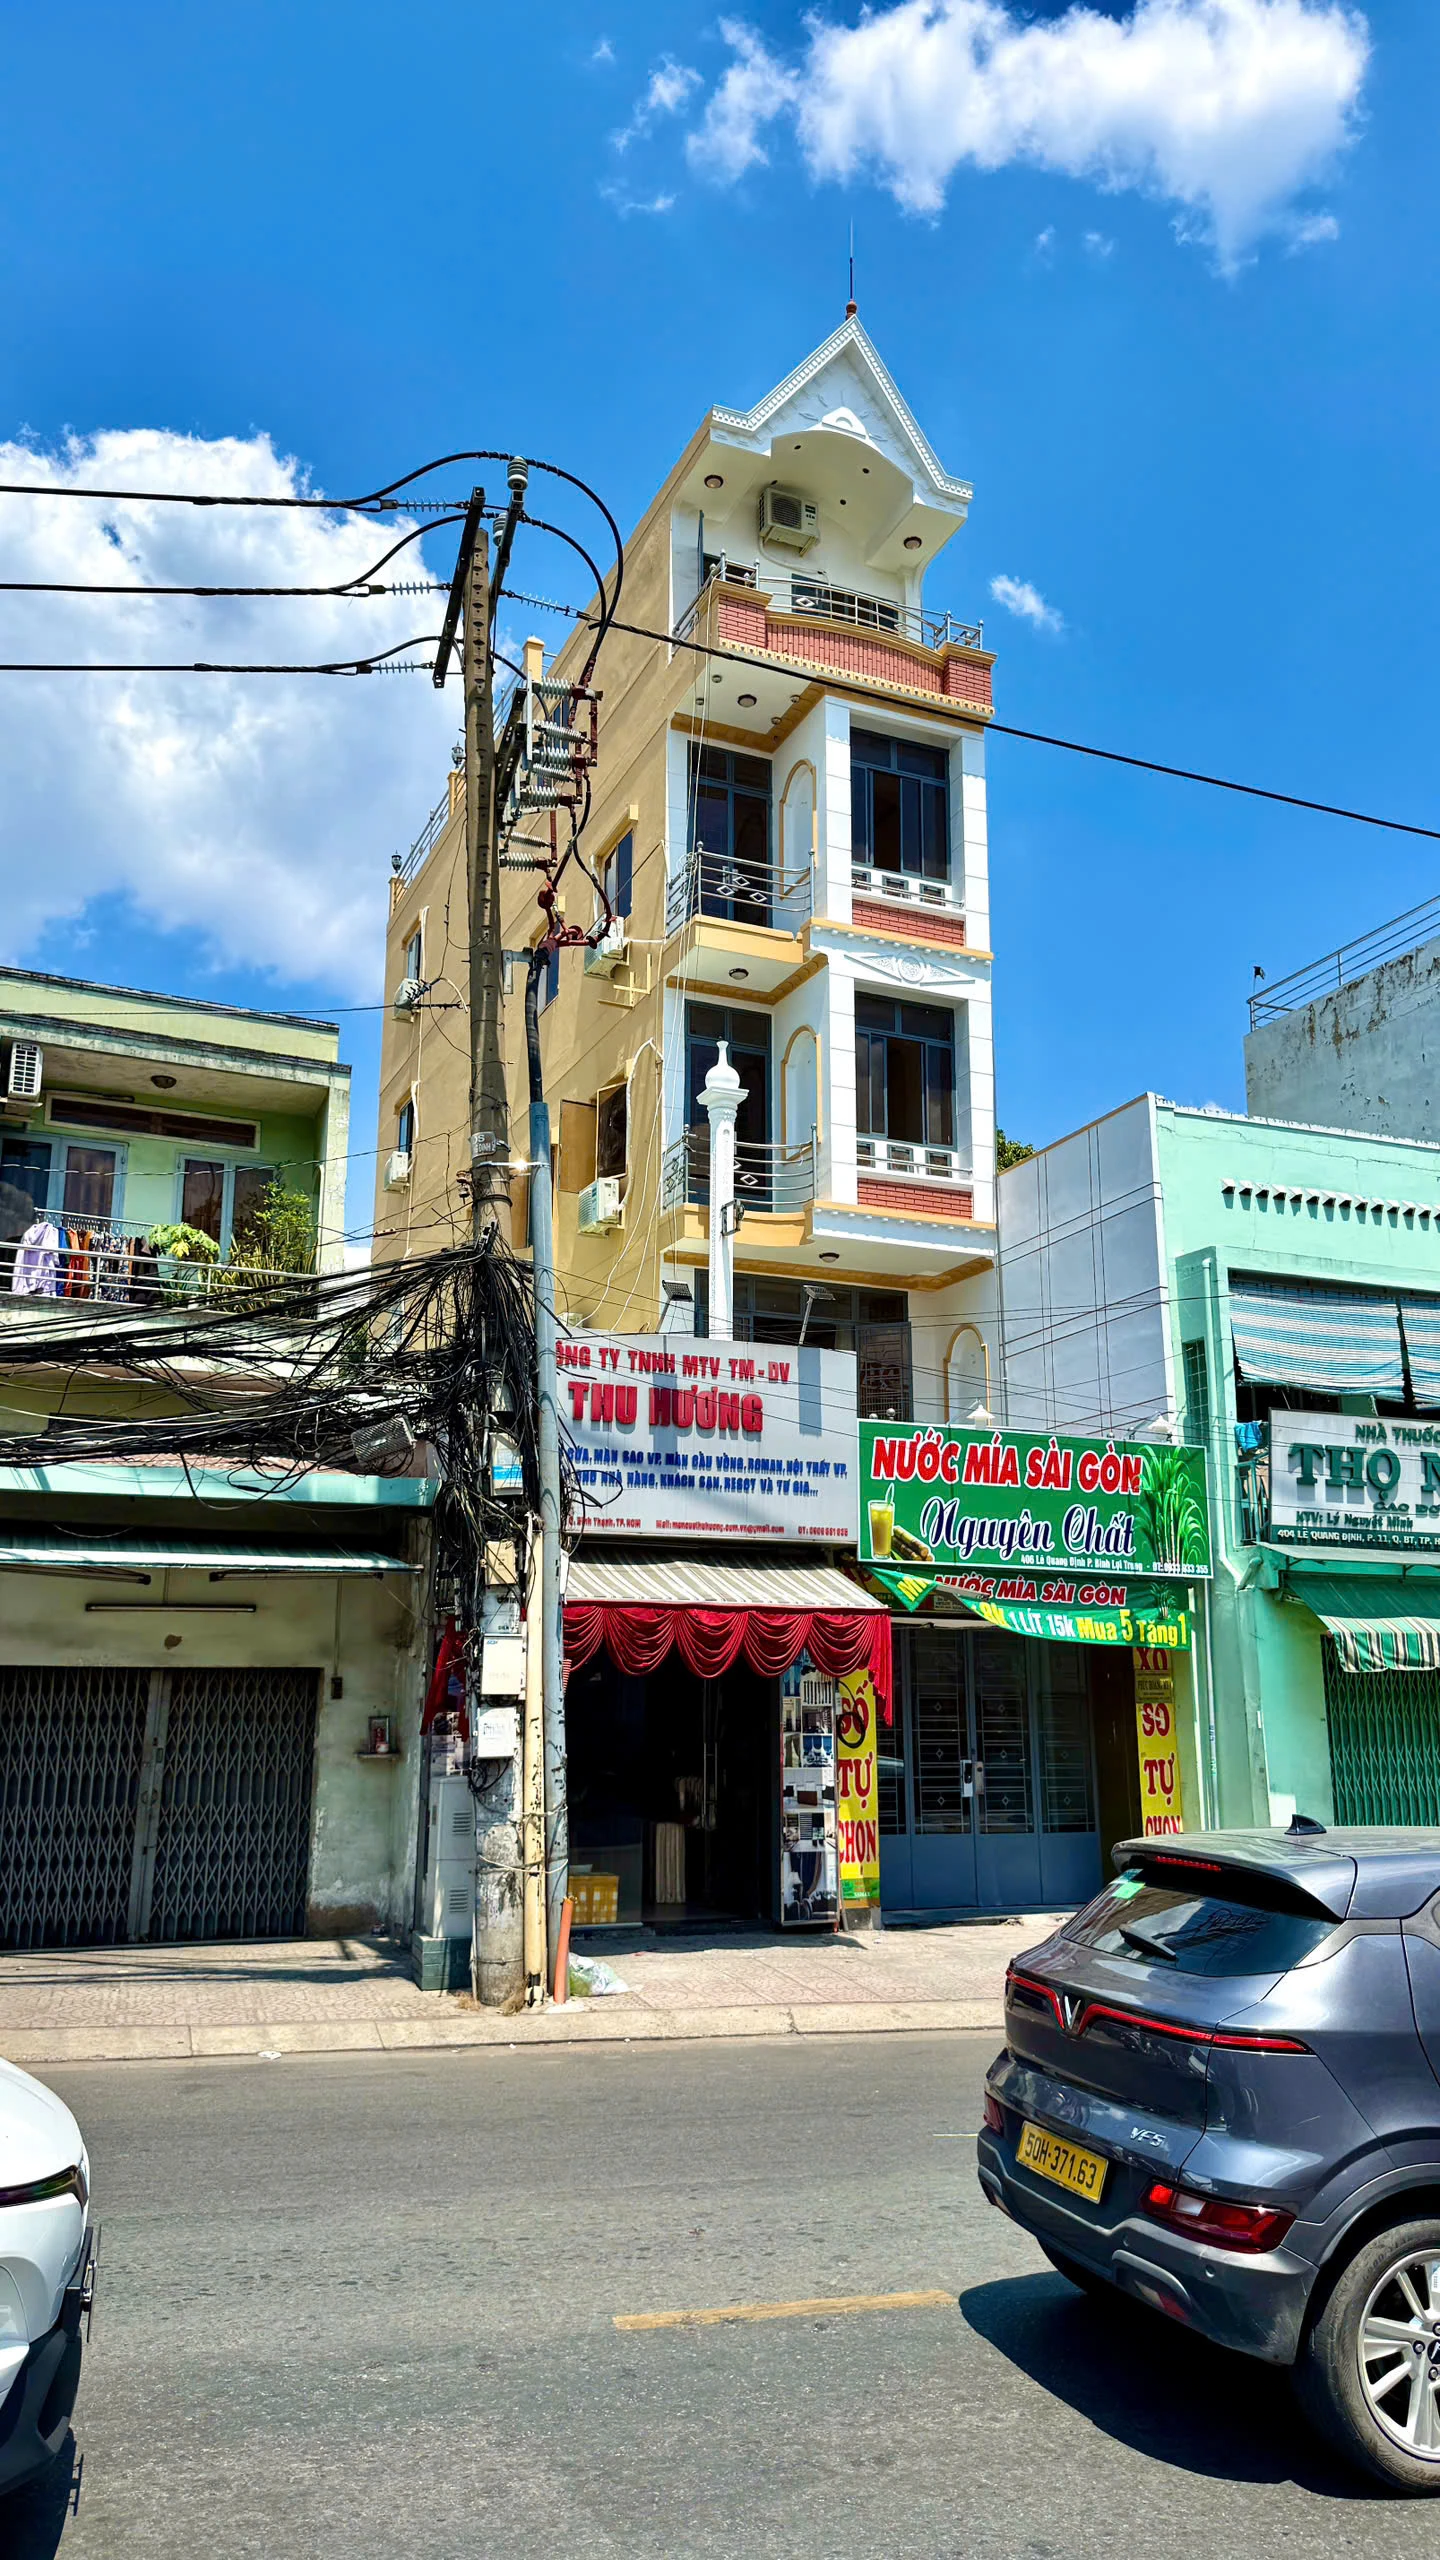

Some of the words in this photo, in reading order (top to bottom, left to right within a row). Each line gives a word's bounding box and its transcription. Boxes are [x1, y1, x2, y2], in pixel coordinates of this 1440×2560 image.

[556, 1339, 591, 1367] ÔNG
[599, 1347, 620, 1369] TY
[628, 1350, 676, 1373] TNHH
[682, 1354, 720, 1378] MTV
[568, 1381, 638, 1424] THU
[648, 1384, 764, 1433] HƯƠNG
[1355, 1422, 1388, 1441] NHÀ
[1391, 1424, 1440, 1443] THUỐC
[593, 1446, 618, 1465] MÀN
[622, 1449, 644, 1466] SAO
[647, 1452, 662, 1465] VP,
[665, 1451, 688, 1468] MÀN
[692, 1451, 712, 1470] CẦU
[748, 1457, 785, 1475] ROMAN,
[786, 1458, 803, 1477] NỘI
[871, 1427, 961, 1484] NƯỚC
[962, 1431, 1021, 1487] MÍA
[1024, 1436, 1073, 1491] SÀI
[1077, 1440, 1144, 1495] GÒN
[1288, 1442, 1401, 1501] THỌ
[627, 1470, 658, 1489] HÀNG,
[660, 1472, 695, 1488] KHÁCH
[760, 1477, 774, 1494] VÀ
[777, 1479, 791, 1495] TƯ
[577, 1515, 592, 1527] Bnh
[1296, 1511, 1324, 1524] KTV:
[1326, 1511, 1340, 1526] Lý
[1386, 1515, 1414, 1531] Minh
[1373, 1501, 1410, 1513] CAO
[921, 1496, 1056, 1560] Nguyên
[1062, 1503, 1137, 1555] Chất
[1277, 1529, 1295, 1538] 404
[1297, 1527, 1309, 1539] LÊ
[1311, 1531, 1340, 1541] QUANG
[1342, 1533, 1365, 1543] ĐỊNH,
[1367, 1534, 1376, 1542] P.
[1392, 1535, 1402, 1544] Q.
[1403, 1535, 1417, 1545] BT,
[1419, 1536, 1433, 1546] TP.
[1046, 1556, 1068, 1568] Quang
[1087, 1558, 1094, 1568] P.
[997, 1576, 1037, 1603] MÍA
[1040, 1577, 1077, 1605] SÀI
[1078, 1581, 1128, 1607] GÒN
[1074, 1616, 1119, 1642] Mua
[1118, 1608, 1135, 1643] 5
[1135, 1618, 1180, 1648] Tặng
[1177, 1611, 1188, 1645] 1
[839, 1752, 873, 1809] TỰ
[1143, 1752, 1175, 1806] TỰ
[1130, 2126, 1167, 2148] VF5
[1024, 2132, 1098, 2189] 50H-371.63
